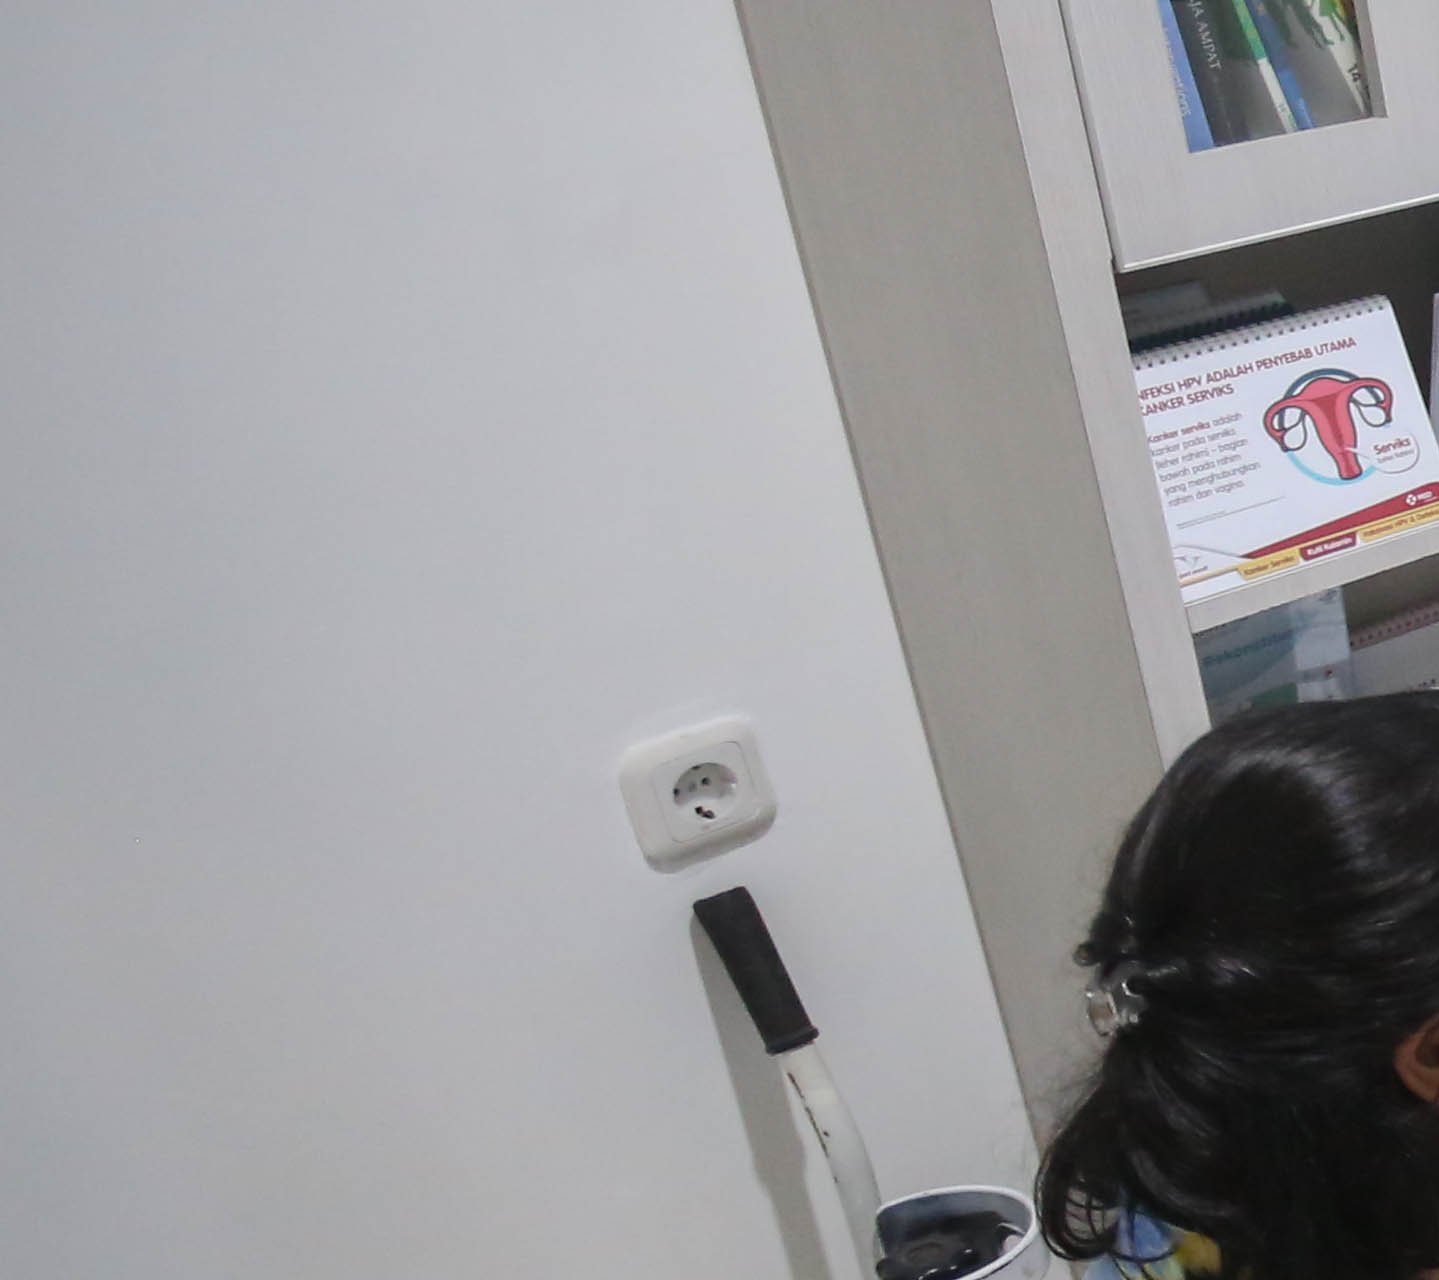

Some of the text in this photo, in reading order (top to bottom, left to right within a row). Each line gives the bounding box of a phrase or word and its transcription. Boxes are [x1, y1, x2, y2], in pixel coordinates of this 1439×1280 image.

[1197, 20, 1222, 71] AMPAT
[1138, 337, 1358, 403] NFEKSI HPV ADALAH PENYEBAB UTAMA
[1187, 384, 1234, 405] SERVIKS
